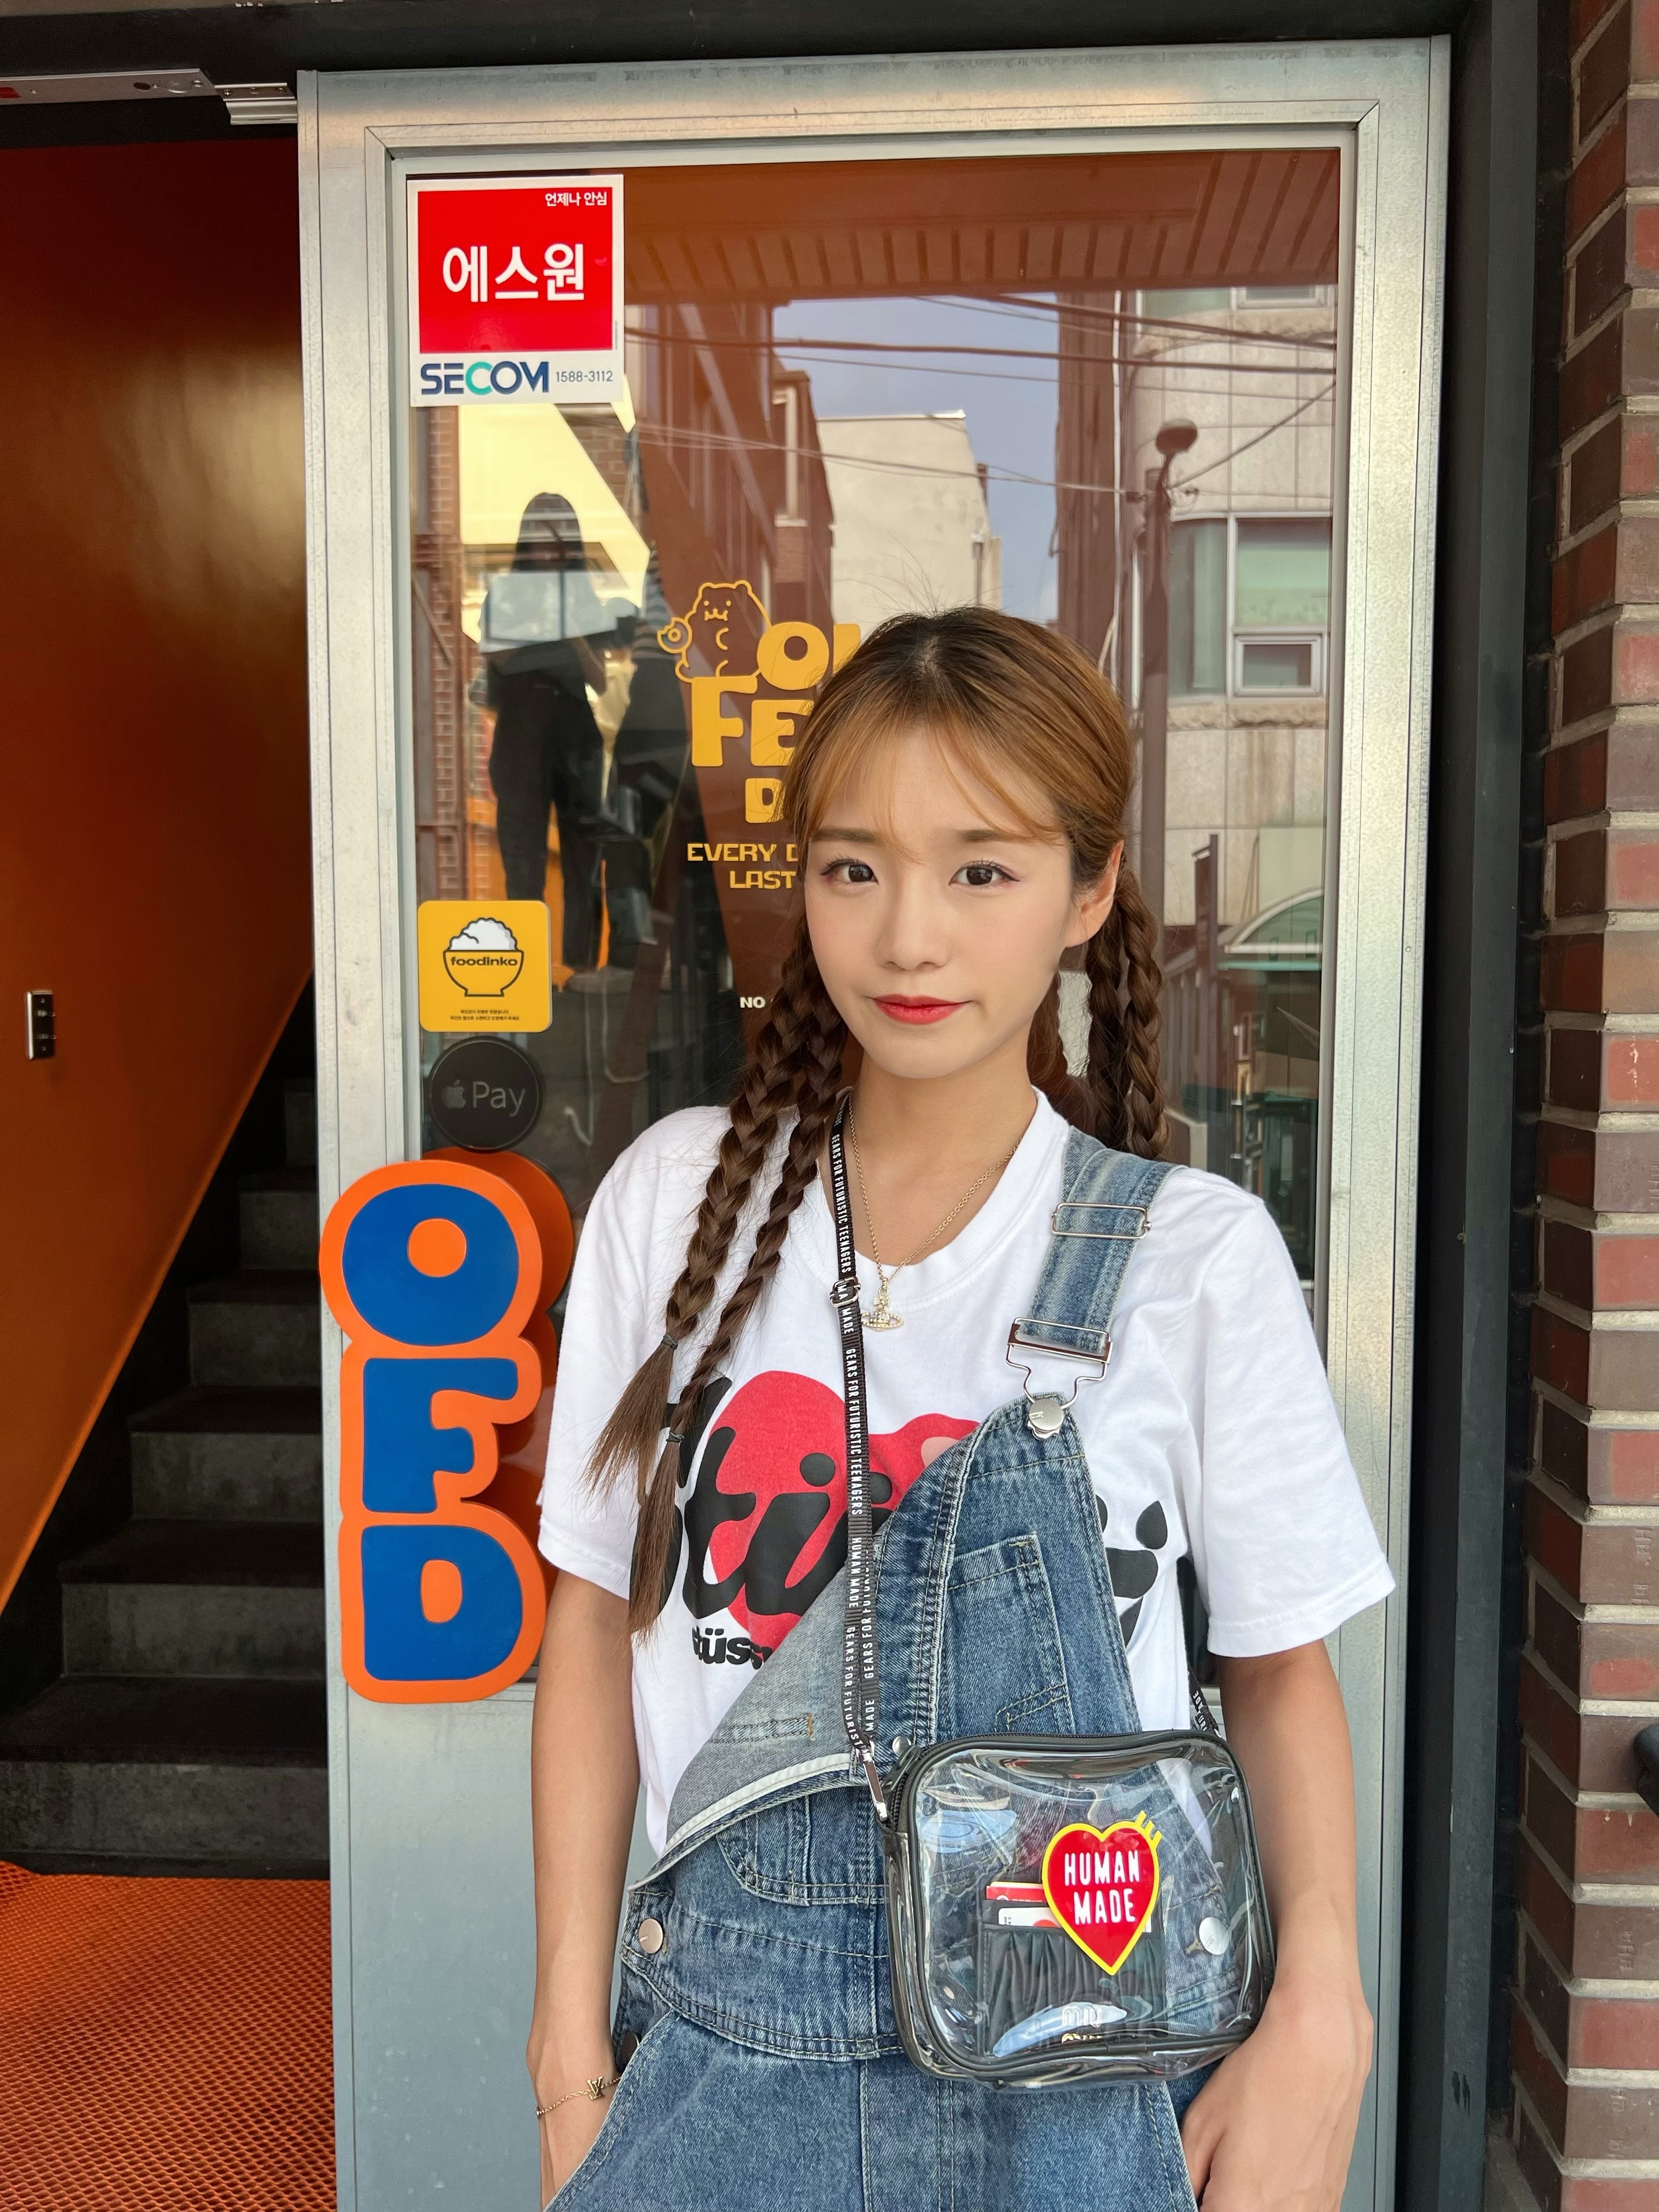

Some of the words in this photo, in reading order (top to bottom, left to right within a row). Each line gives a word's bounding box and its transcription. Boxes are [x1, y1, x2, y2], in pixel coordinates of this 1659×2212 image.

[545, 192, 582, 207] 언제나
[583, 191, 607, 206] 안심
[442, 243, 585, 303] 에스원
[421, 361, 549, 395] SECOM
[556, 370, 613, 382] 1588-3112
[687, 843, 777, 862] EVERY
[730, 871, 797, 889] LAST
[450, 956, 518, 967] foodinko
[740, 997, 766, 1008] NO
[472, 1081, 526, 1117] Pay
[832, 1134, 841, 1159] GEARS
[833, 1160, 843, 1176] FOR
[834, 1176, 848, 1224] FUTURISTIC
[839, 1225, 851, 1273] TEENAGERS
[842, 1308, 854, 1334] MADE
[845, 1348, 858, 1378] GEARS
[848, 1380, 859, 1397] FOR
[849, 1400, 862, 1455] FUTURISTIC
[850, 1458, 863, 1515] TEENAGERS
[850, 1537, 862, 1575] HUMAN
[849, 1578, 861, 1608] MADE
[861, 1617, 873, 1638] FOR
[845, 1627, 856, 1662] GEARS
[862, 1642, 874, 1679] GEARS
[844, 1666, 854, 1688] FOR
[865, 1699, 875, 1731] MADE
[1064, 1849, 1140, 1886] HUMAN
[1074, 1888, 1136, 1925] MADE
